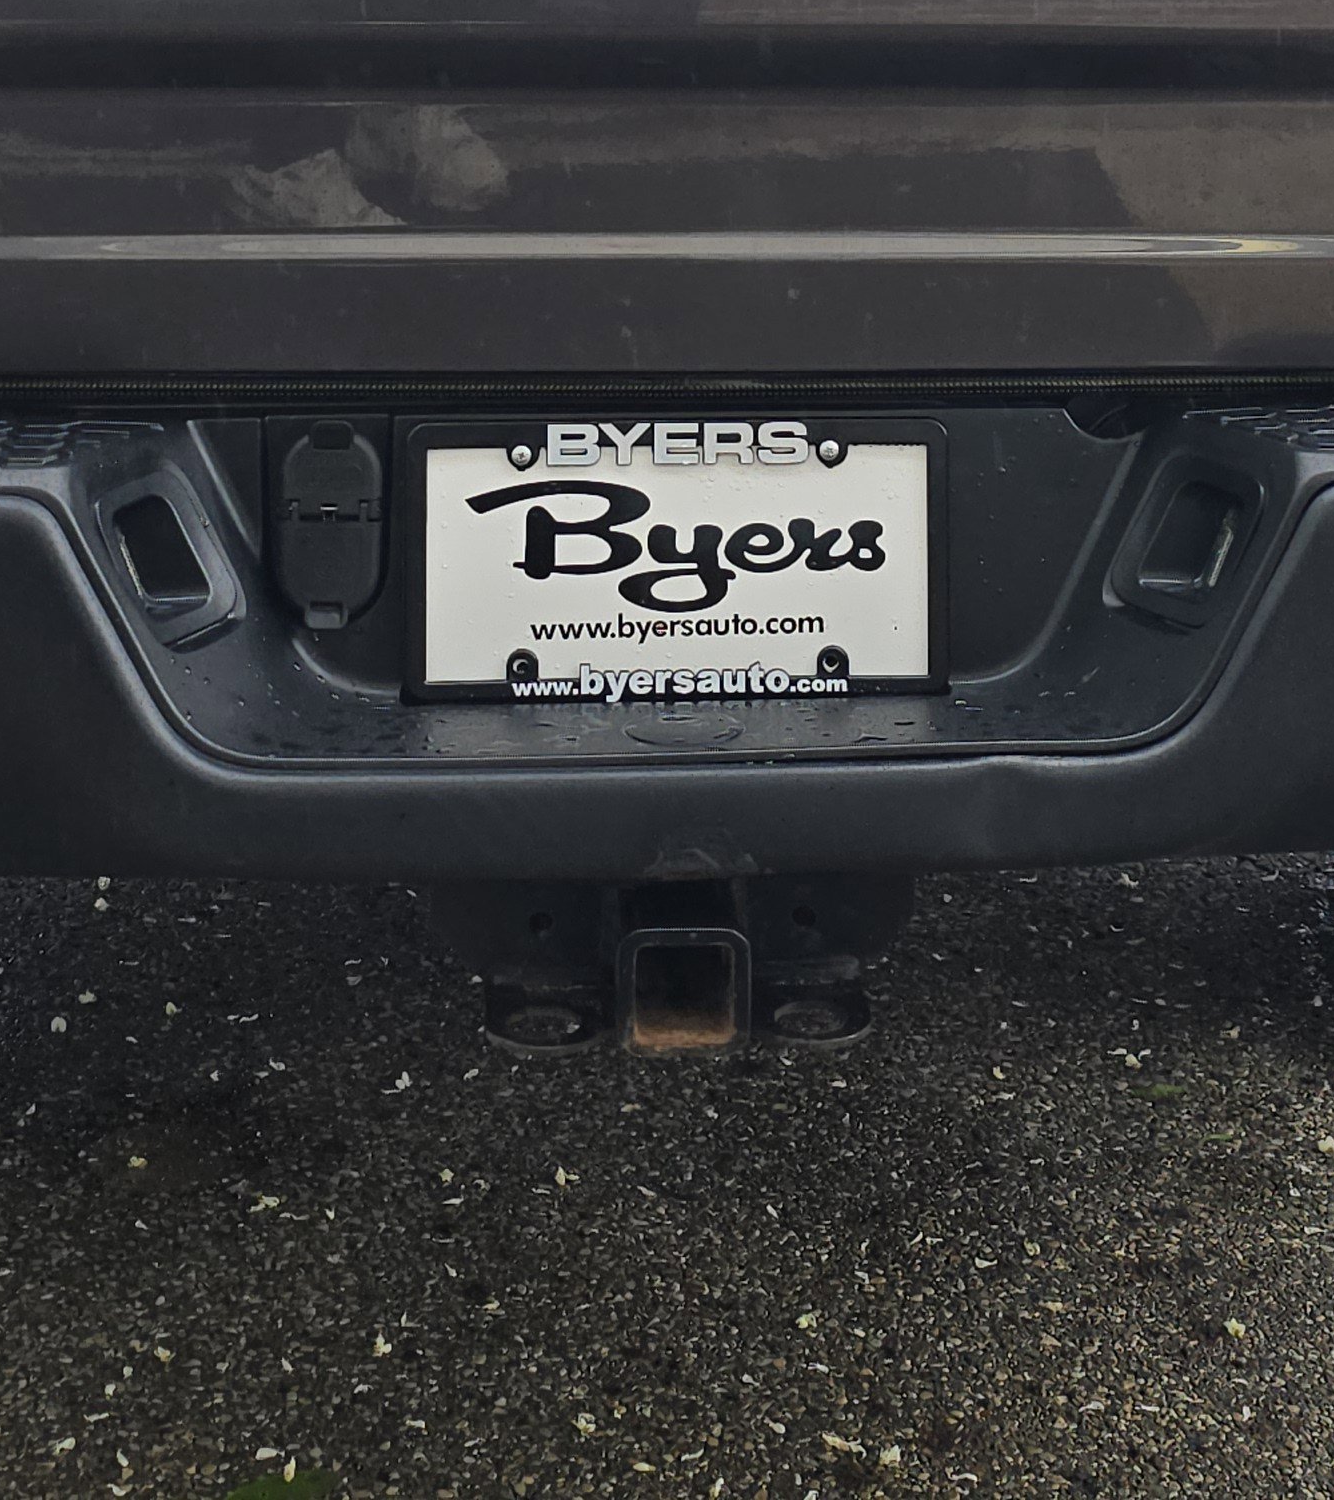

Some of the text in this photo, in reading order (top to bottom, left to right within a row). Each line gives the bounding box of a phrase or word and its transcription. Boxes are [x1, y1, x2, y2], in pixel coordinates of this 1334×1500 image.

[545, 420, 809, 468] BYERS
[465, 479, 886, 612] Byers
[530, 612, 825, 644] www.byersauto.com
[512, 660, 849, 703] www.byersauto.com
